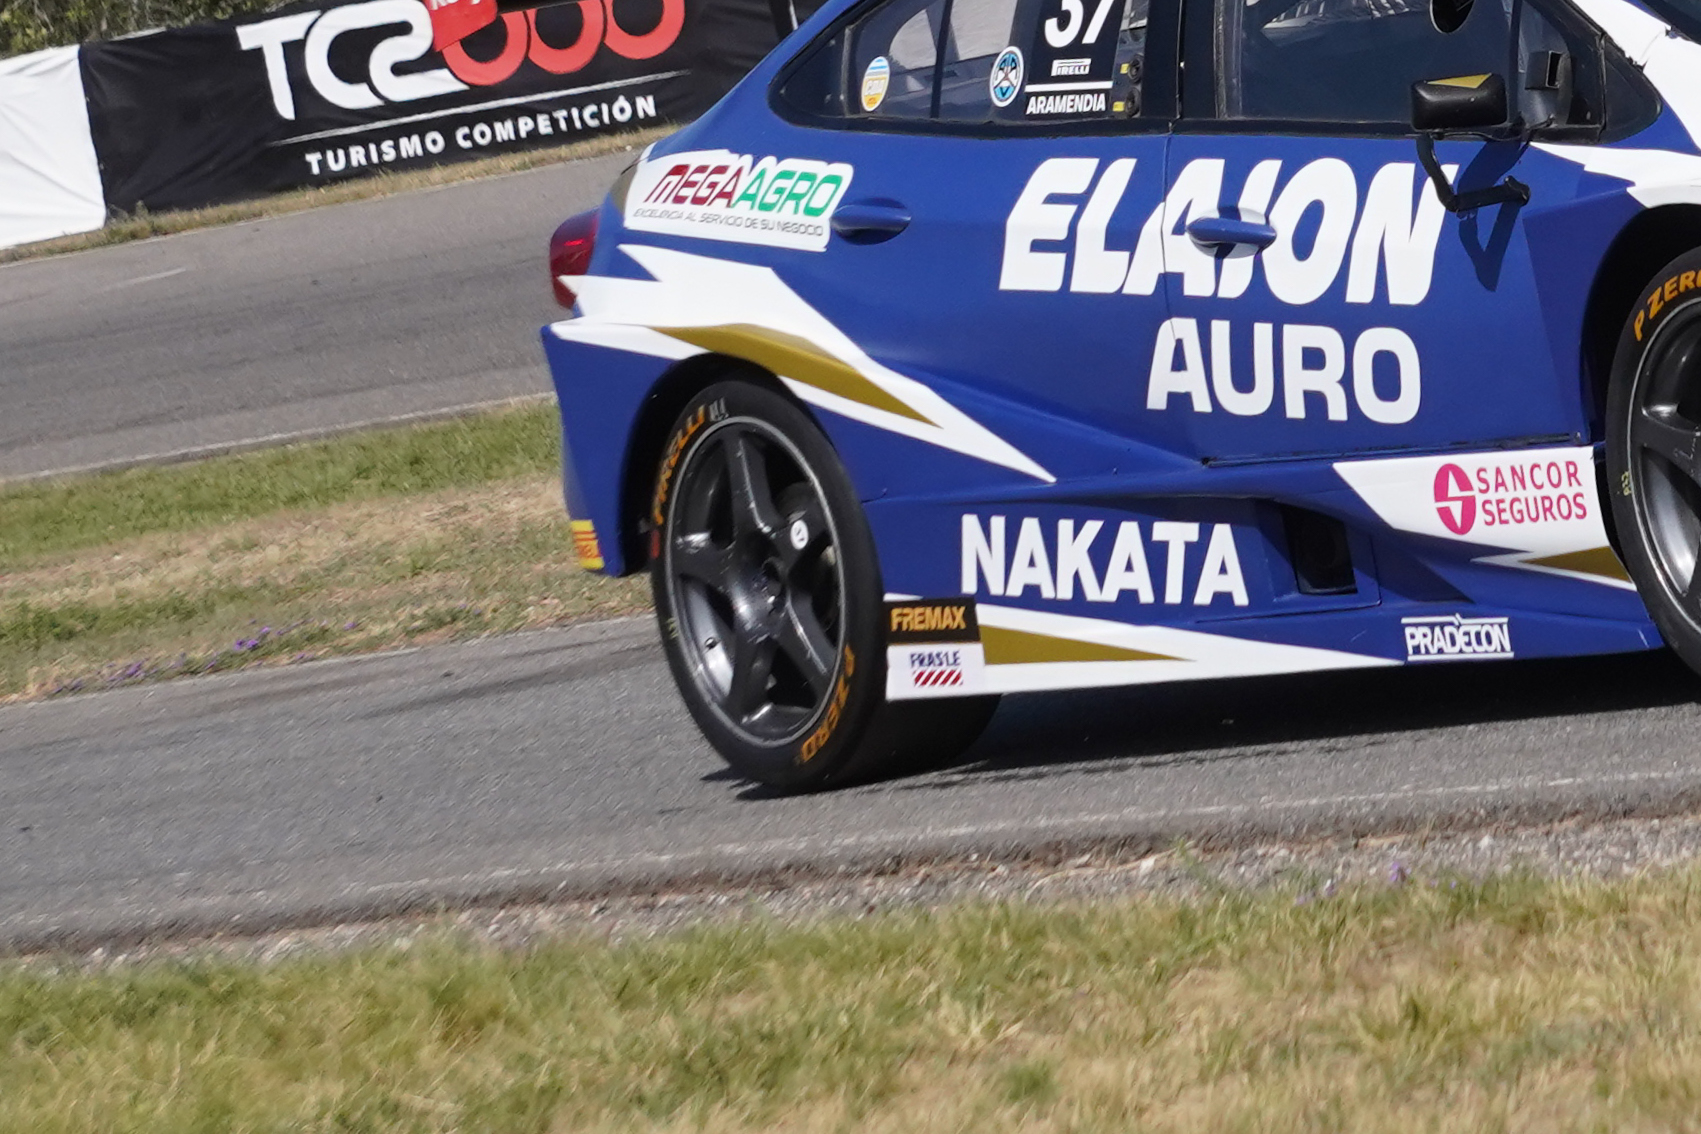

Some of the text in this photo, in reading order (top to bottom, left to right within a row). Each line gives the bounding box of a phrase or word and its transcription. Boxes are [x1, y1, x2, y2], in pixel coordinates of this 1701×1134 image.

[1051, 58, 1092, 77] PIRELLI
[1026, 93, 1106, 115] ARAMENDIA
[304, 95, 657, 175] TURISMO COMPETICIÓN
[697, 213, 743, 228] SERVICIO
[744, 218, 759, 229] DE
[761, 219, 776, 231] SU
[777, 221, 824, 237] NEGOCIO
[1000, 157, 1459, 306] ELAION
[1633, 311, 1647, 342] P
[1147, 318, 1421, 425] AURO
[1475, 460, 1583, 496] SANCOR
[1482, 491, 1588, 528] SEGUROS
[961, 514, 1249, 606] NAKATA
[890, 605, 967, 632] FREMAX
[1404, 624, 1511, 656] PRADECON
